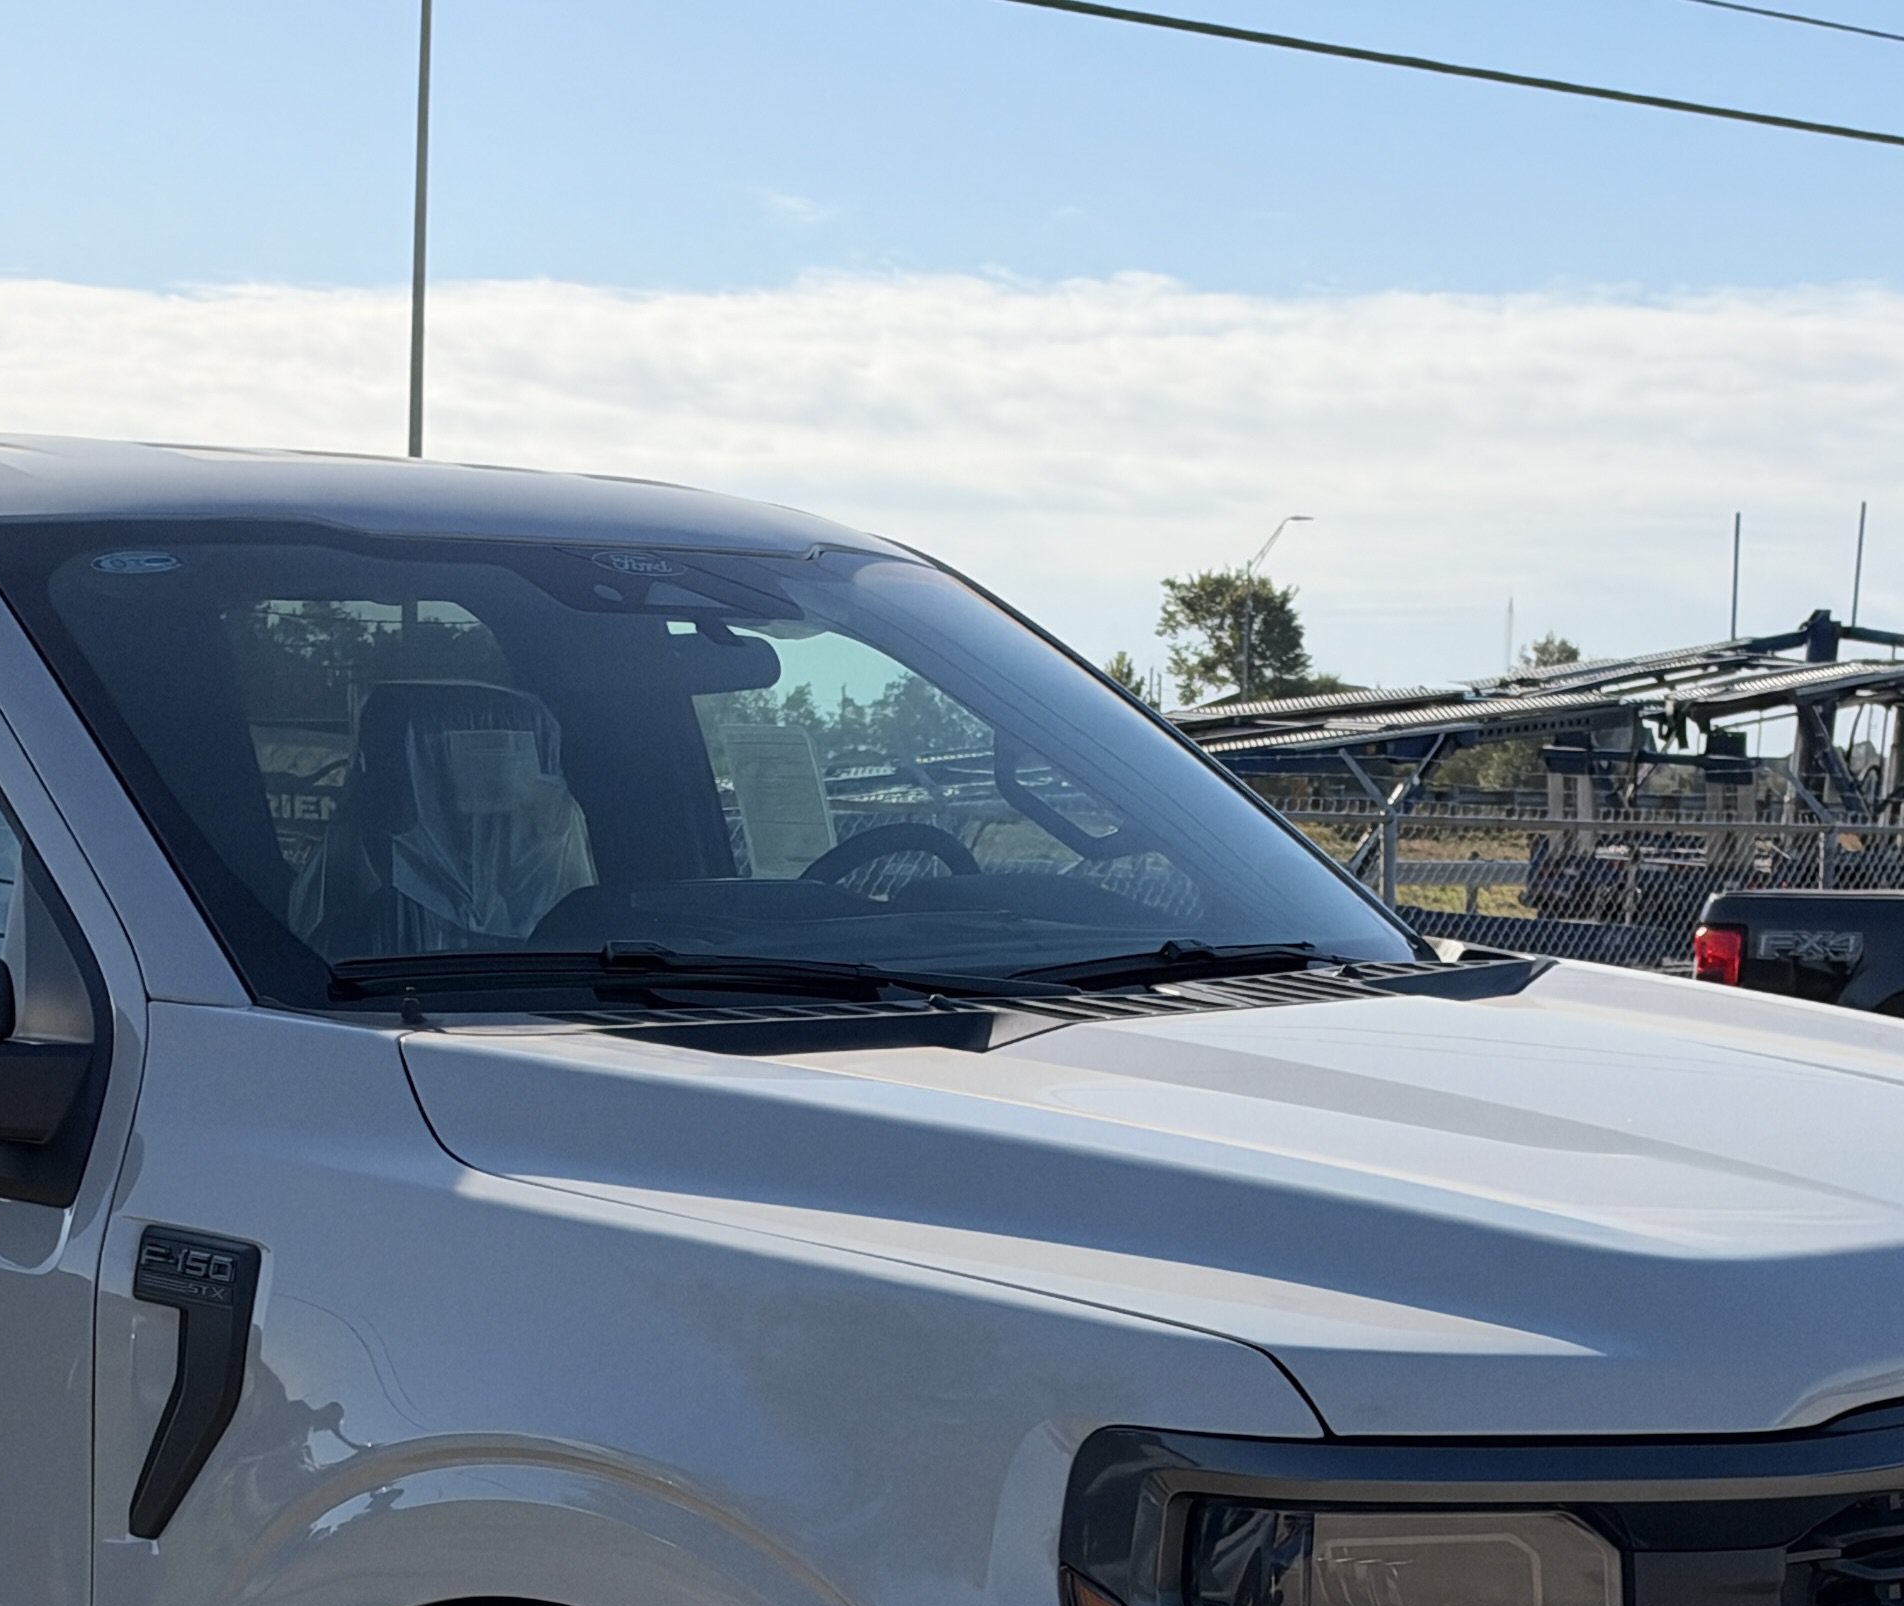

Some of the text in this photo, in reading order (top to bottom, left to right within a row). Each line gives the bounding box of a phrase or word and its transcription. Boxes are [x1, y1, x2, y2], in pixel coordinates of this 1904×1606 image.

[1756, 930, 1865, 961] FX4
[140, 1244, 236, 1283] F-150
[187, 1283, 225, 1300] STX
